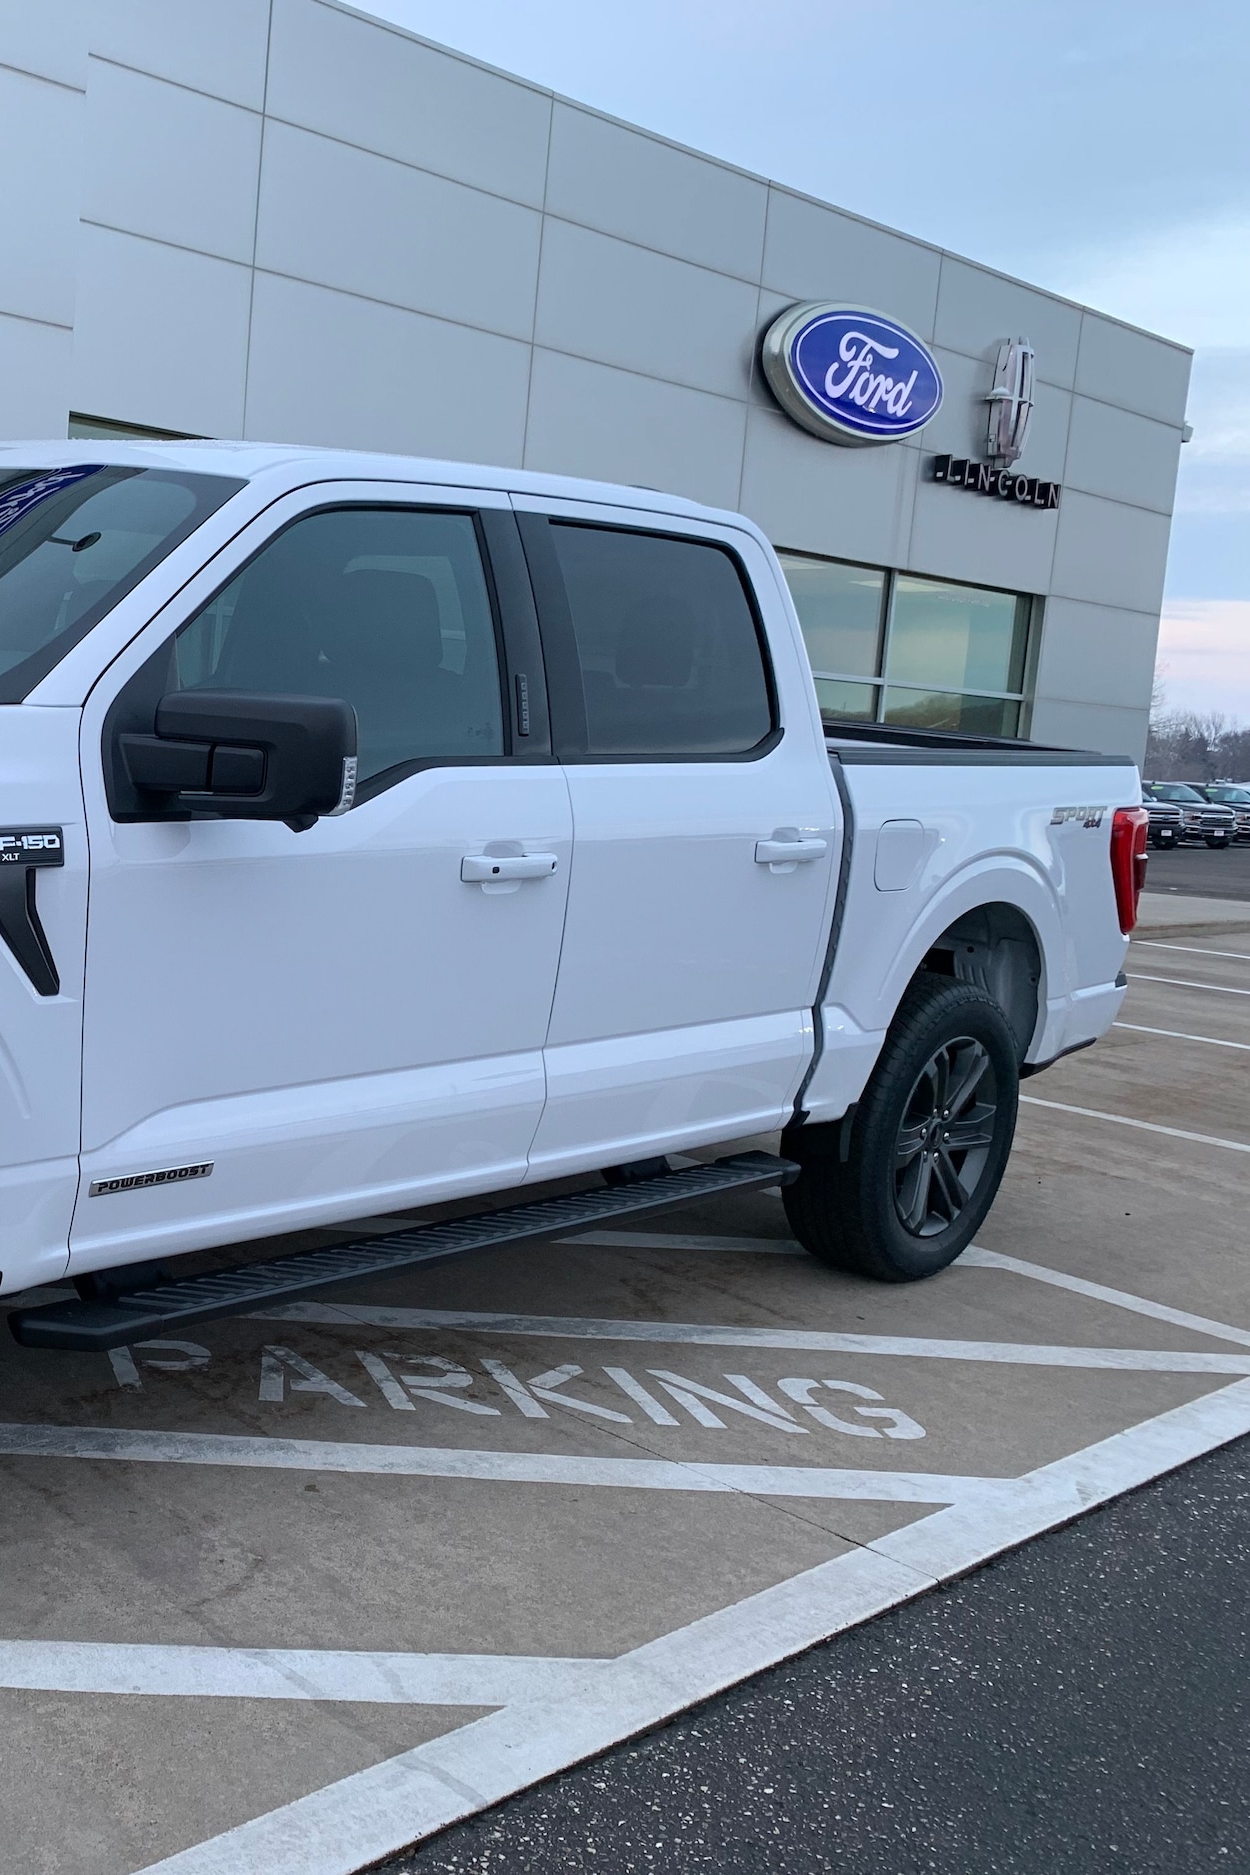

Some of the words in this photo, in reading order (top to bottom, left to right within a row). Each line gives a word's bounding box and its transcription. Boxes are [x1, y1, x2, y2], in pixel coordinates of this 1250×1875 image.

[824, 331, 919, 418] Ford
[939, 453, 1062, 511] LINCOLN
[1, 852, 20, 862] XLT
[97, 1163, 210, 1193] POWERBOOST
[107, 1338, 928, 1441] PARKING
